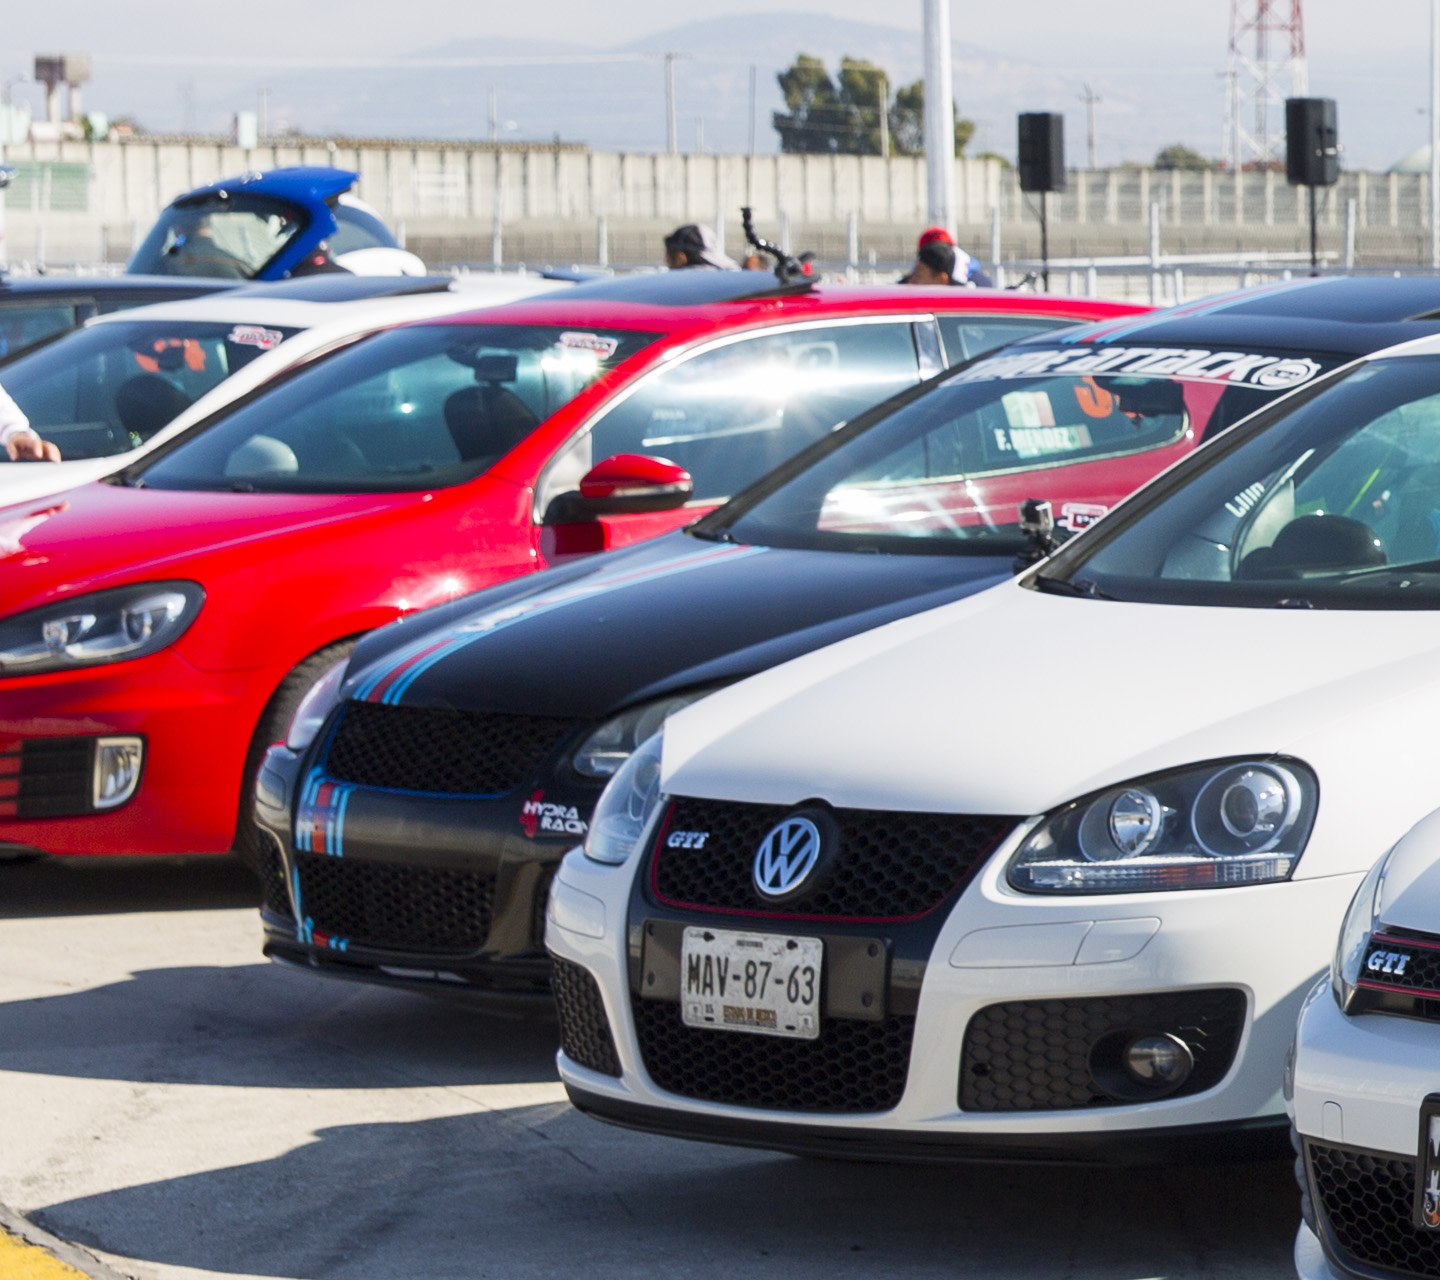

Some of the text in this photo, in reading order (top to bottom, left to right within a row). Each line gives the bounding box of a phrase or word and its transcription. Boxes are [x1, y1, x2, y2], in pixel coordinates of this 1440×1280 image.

[523, 800, 579, 819] HYDRA
[667, 830, 709, 849] GTI
[755, 817, 820, 895] VW
[1367, 950, 1410, 975] GTI
[687, 953, 816, 1006] MAV-87-63
